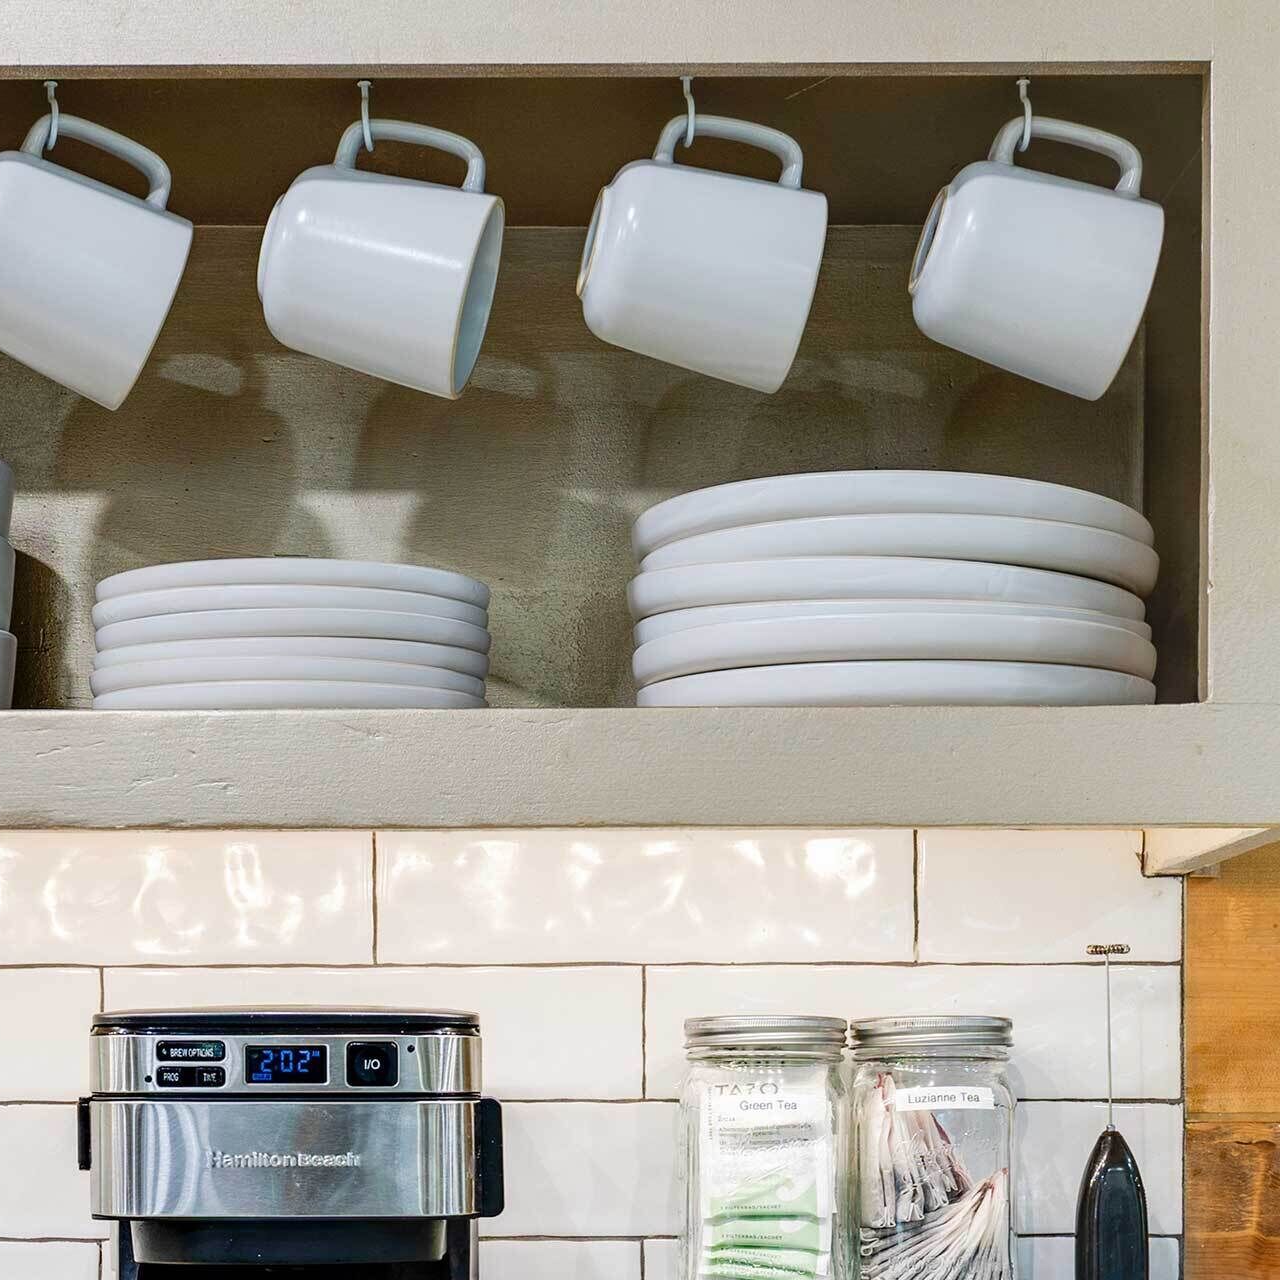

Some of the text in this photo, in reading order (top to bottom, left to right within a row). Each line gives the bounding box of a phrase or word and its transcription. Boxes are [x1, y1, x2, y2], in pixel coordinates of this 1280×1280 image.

[170, 1048, 188, 1057] BREW
[364, 1059, 381, 1070] I/O
[163, 1073, 179, 1082] PROG
[908, 1091, 980, 1104] Luzianne Tea
[740, 1100, 798, 1111] Green Tea
[207, 1152, 296, 1168] Hamilton
